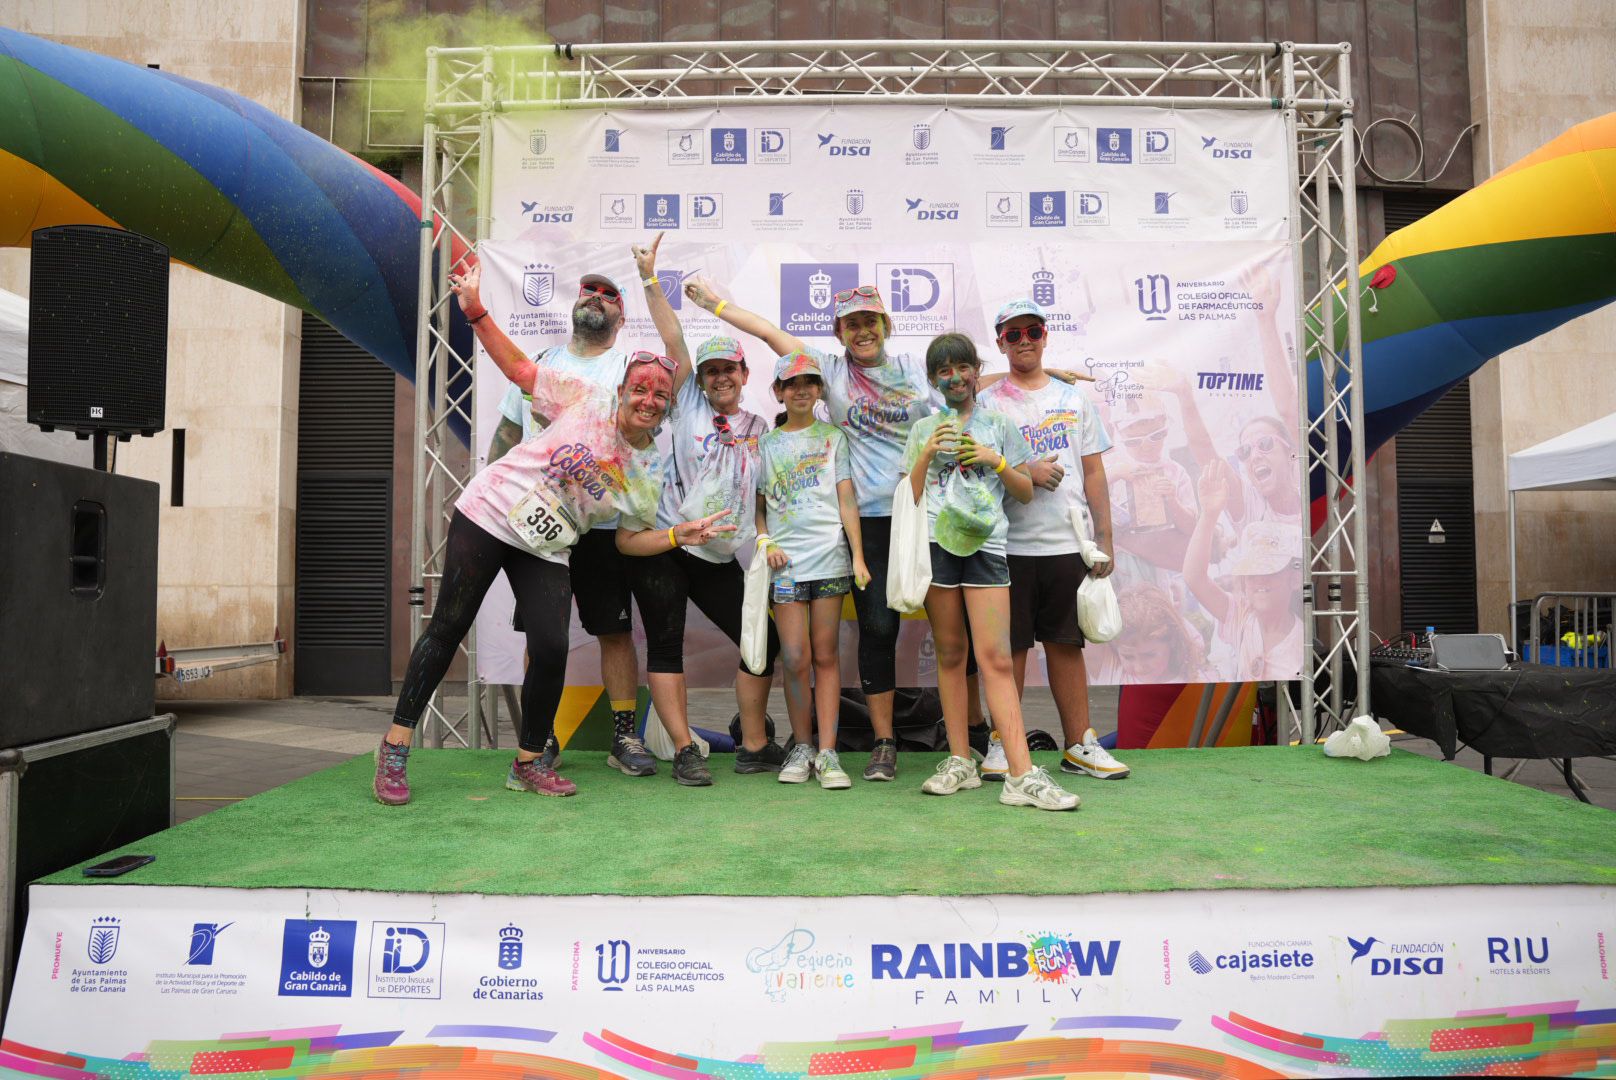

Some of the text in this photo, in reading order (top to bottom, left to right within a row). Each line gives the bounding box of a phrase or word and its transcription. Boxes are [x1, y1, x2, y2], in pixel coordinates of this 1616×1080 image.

[1177, 292, 1253, 300] COLEGIO OFICIAL
[1192, 301, 1264, 310] FARMACÉUTICOS
[510, 312, 568, 322] Ayuntamiento
[791, 313, 830, 322] Cabildo
[1046, 313, 1071, 321] erno
[1178, 313, 1196, 321] LAS
[510, 319, 568, 328] de Las Palmas
[787, 322, 812, 331] Gran
[898, 322, 945, 331] DEPORTES
[509, 327, 567, 336] de Gran Canaria
[1197, 372, 1264, 390] TOPTIME
[1053, 423, 1066, 432] en
[527, 507, 563, 541] 356
[1034, 943, 1065, 960] FUN
[1391, 942, 1444, 954] FUNDACIÓN
[1487, 937, 1549, 963] RIU
[52, 932, 63, 980] PROMUEVE
[1597, 932, 1609, 980] PROMOTOR
[572, 940, 580, 991] PATROCINA
[637, 961, 713, 970] COLEGIO OFICIAL
[1037, 956, 1067, 973] RUN
[1216, 950, 1314, 972] cajasiete
[1371, 957, 1443, 975] DISA
[72, 969, 128, 977] Ayuntamiento
[290, 972, 341, 981] Cabildo de
[636, 972, 724, 981] DE FARMACÉUTICOS
[480, 976, 537, 987] Gobierno
[81, 985, 97, 993] Gran
[284, 982, 347, 992] Gran Canaria
[388, 985, 431, 994] DEPORTES
[473, 989, 543, 1000] de Canarias
[915, 987, 1082, 1005] FAMILY
